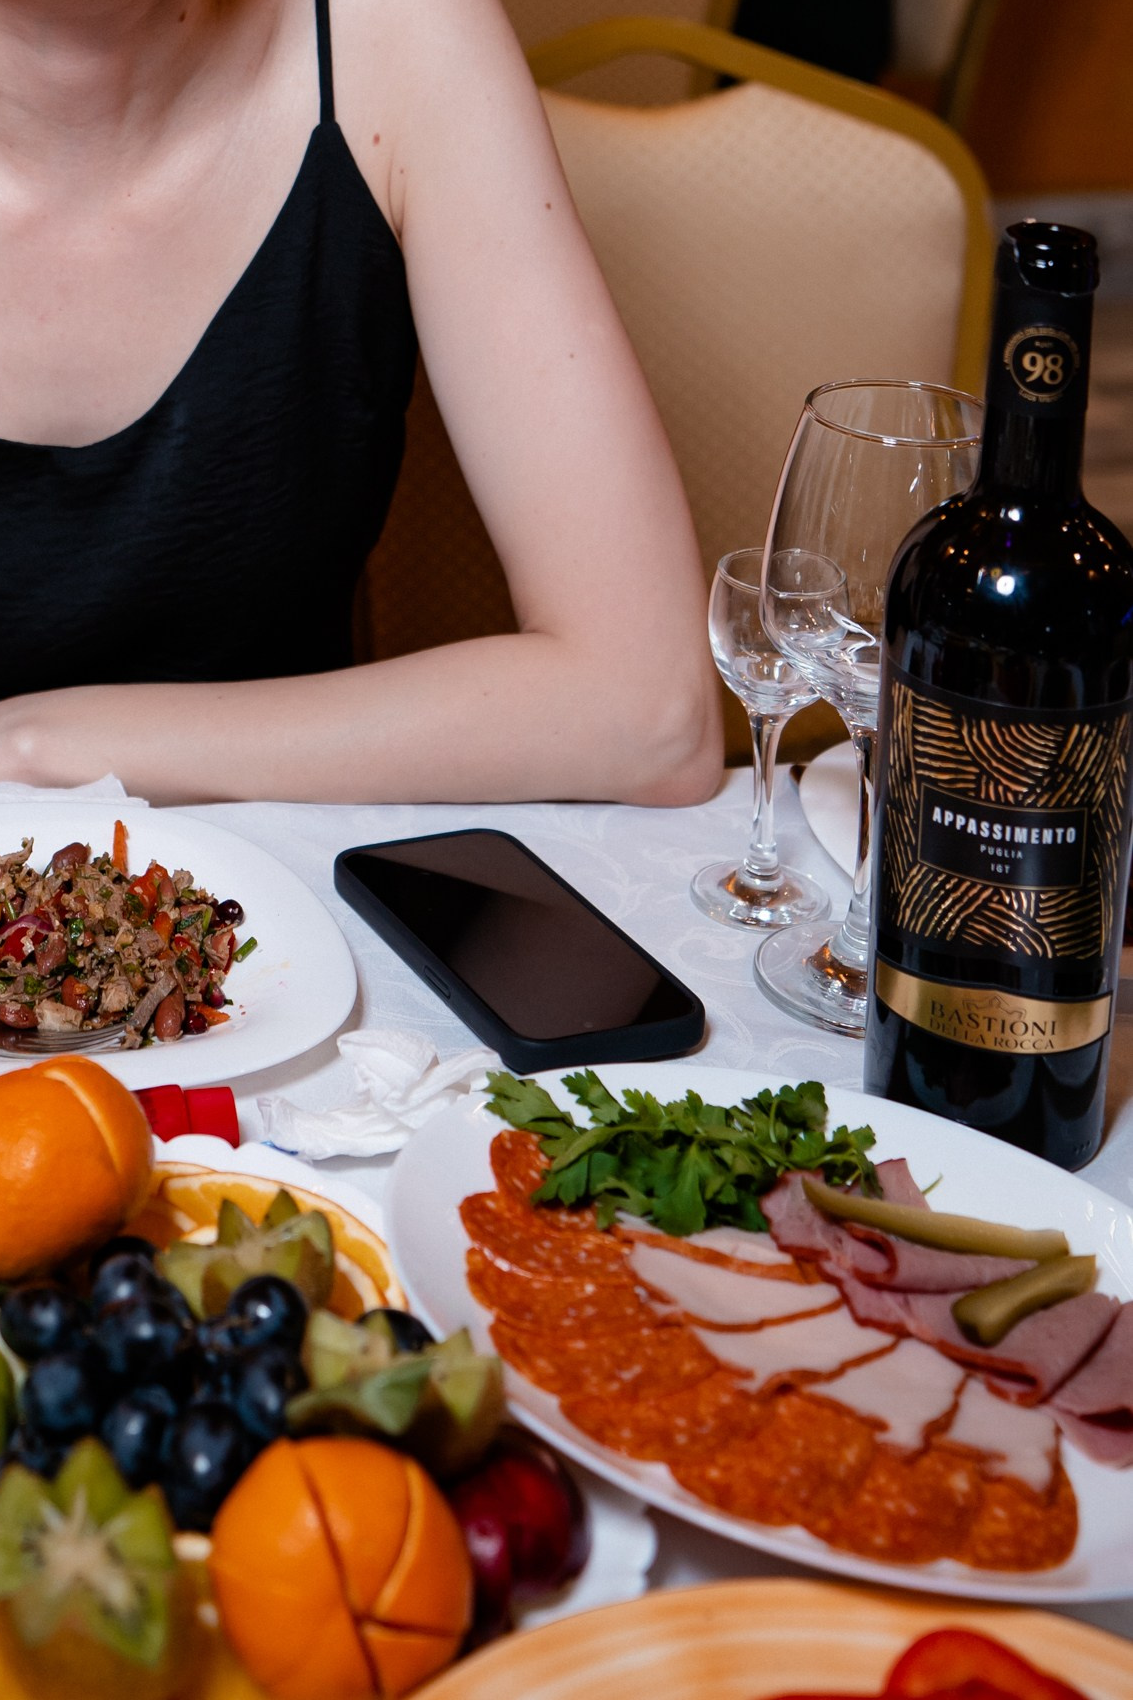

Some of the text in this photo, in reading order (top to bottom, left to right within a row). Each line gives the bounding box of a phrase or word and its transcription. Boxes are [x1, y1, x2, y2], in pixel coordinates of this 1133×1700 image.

[1021, 350, 1065, 386] 98
[932, 806, 1077, 844] APPASSIMENTO
[979, 844, 1024, 860] PUGLIA
[990, 862, 1011, 875] IGT
[930, 1000, 1057, 1037] BASTIONI
[994, 1038, 1055, 1051] ROCCA
